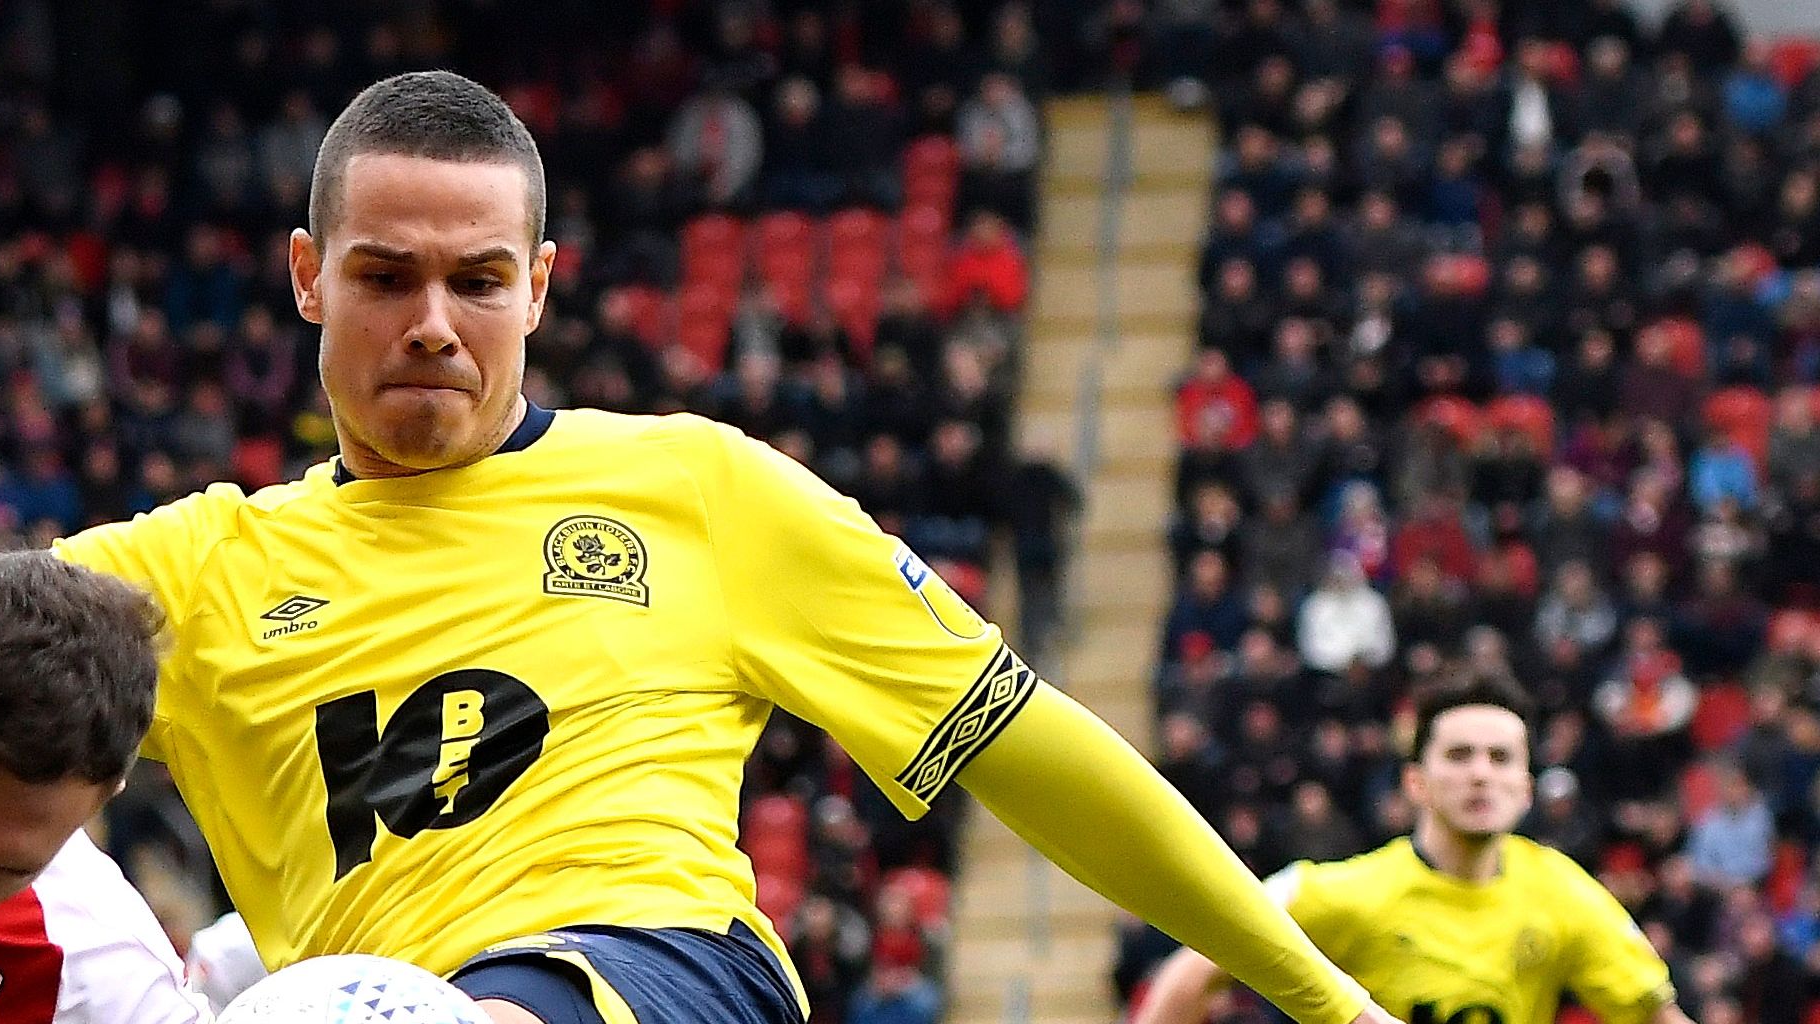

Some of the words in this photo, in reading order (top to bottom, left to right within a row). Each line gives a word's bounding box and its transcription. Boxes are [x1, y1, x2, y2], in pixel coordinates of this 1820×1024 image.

[553, 521, 595, 567] BLACKBURN
[598, 523, 638, 557] ROVERS
[262, 620, 318, 640] umbro
[431, 689, 485, 816] BET
